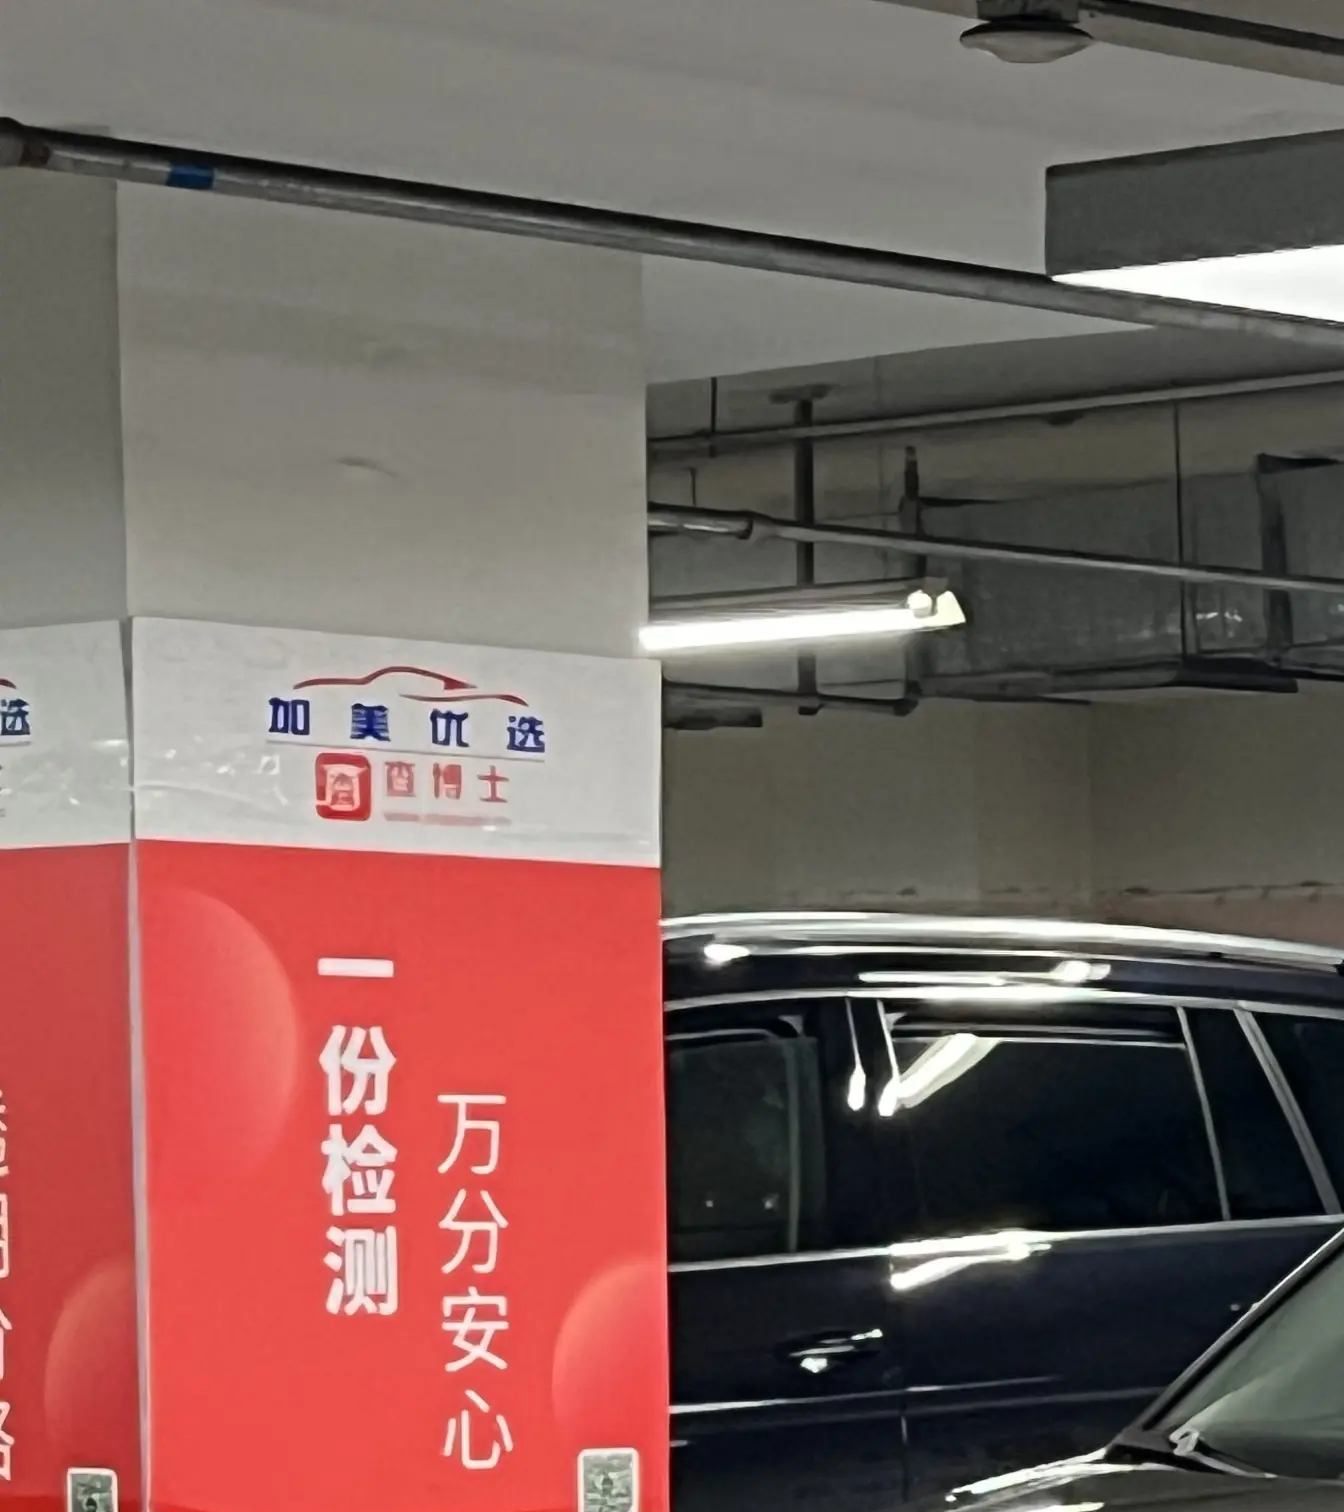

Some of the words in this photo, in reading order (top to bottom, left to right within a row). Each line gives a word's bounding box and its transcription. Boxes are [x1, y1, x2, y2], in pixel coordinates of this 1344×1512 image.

[269, 697, 545, 753] 加美优选
[316, 957, 399, 1317] 一份检测
[436, 1094, 514, 1470] 万分安心
